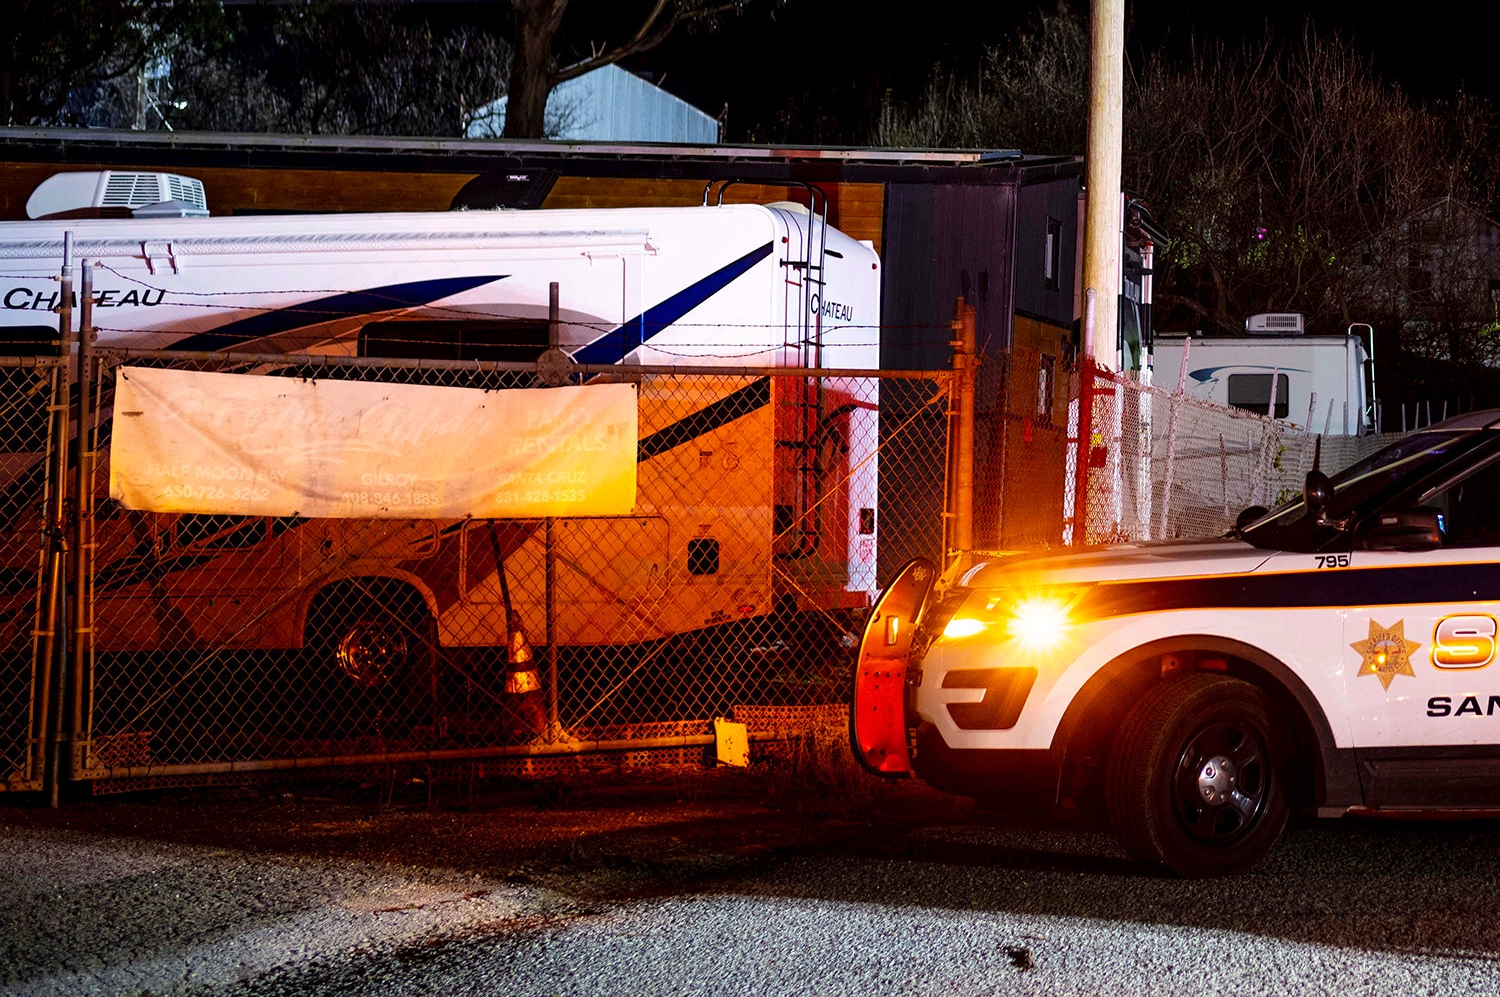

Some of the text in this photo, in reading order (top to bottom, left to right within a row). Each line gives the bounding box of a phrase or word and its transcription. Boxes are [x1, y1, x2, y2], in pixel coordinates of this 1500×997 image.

[3, 287, 167, 309] CHAEAU
[507, 433, 608, 455] RENTALS
[146, 464, 190, 477] HALF
[195, 465, 253, 481] MOON
[361, 473, 418, 486] GILROY
[496, 471, 586, 485] SANTA CRUZ
[1315, 555, 1349, 569] 795
